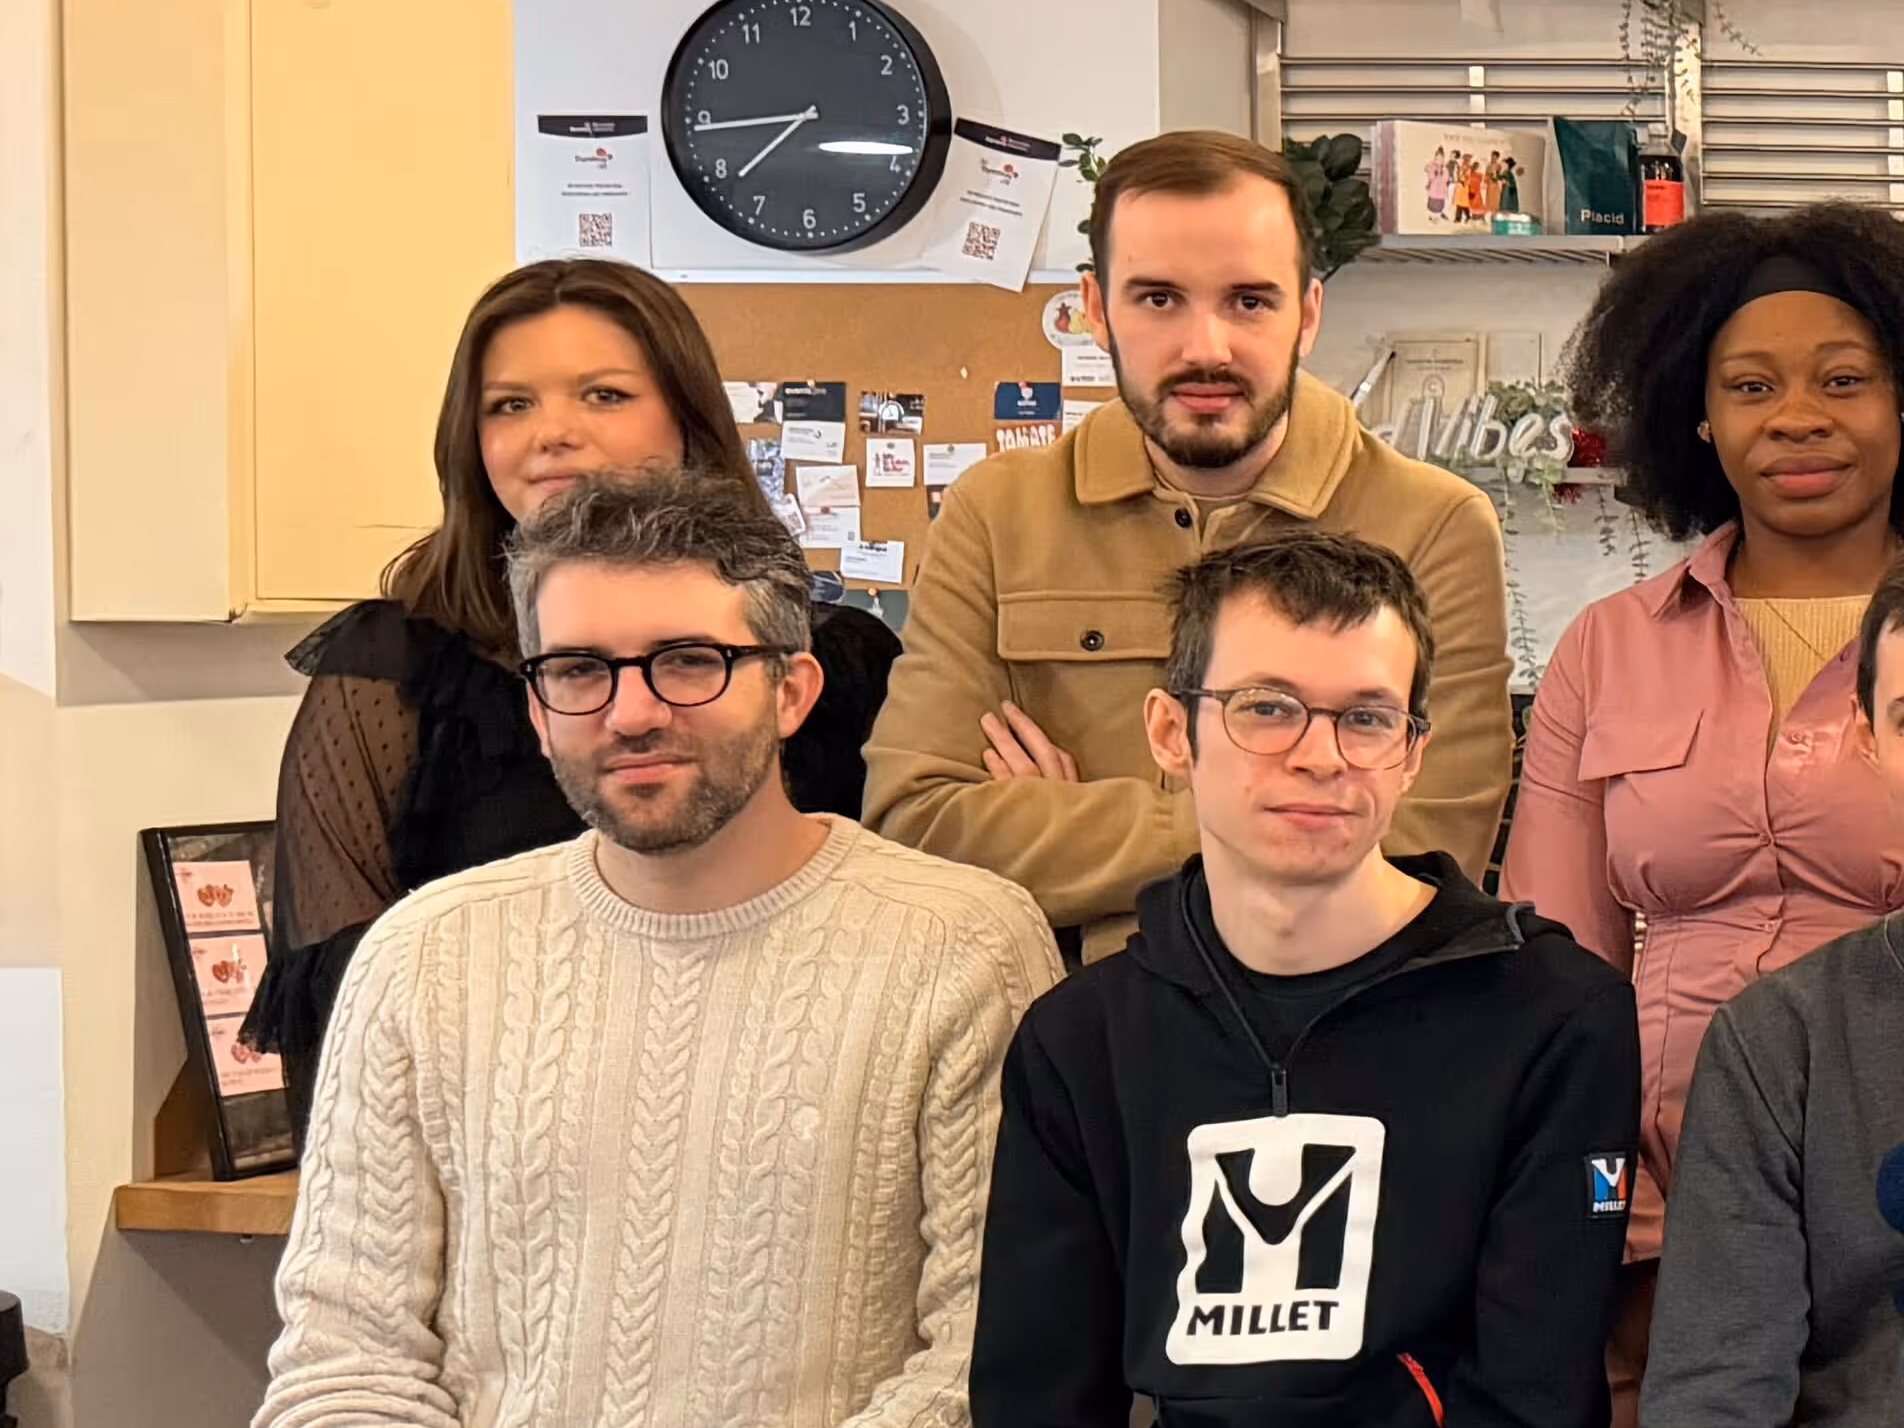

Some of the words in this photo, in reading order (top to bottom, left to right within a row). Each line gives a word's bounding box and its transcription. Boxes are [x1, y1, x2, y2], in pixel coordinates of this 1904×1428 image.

[790, 6, 811, 27] 12
[742, 23, 760, 44] 11
[848, 21, 857, 42] 1
[708, 59, 729, 80] 10
[880, 55, 893, 75] 2
[896, 104, 910, 125] 3
[715, 158, 728, 179] 8
[889, 155, 901, 173] 4
[752, 195, 766, 215] 7
[852, 192, 866, 213] 5
[802, 208, 816, 229] 6
[1580, 209, 1625, 225] Placid
[1418, 395, 1576, 463] Vibes
[1186, 1300, 1340, 1336] MILLET
